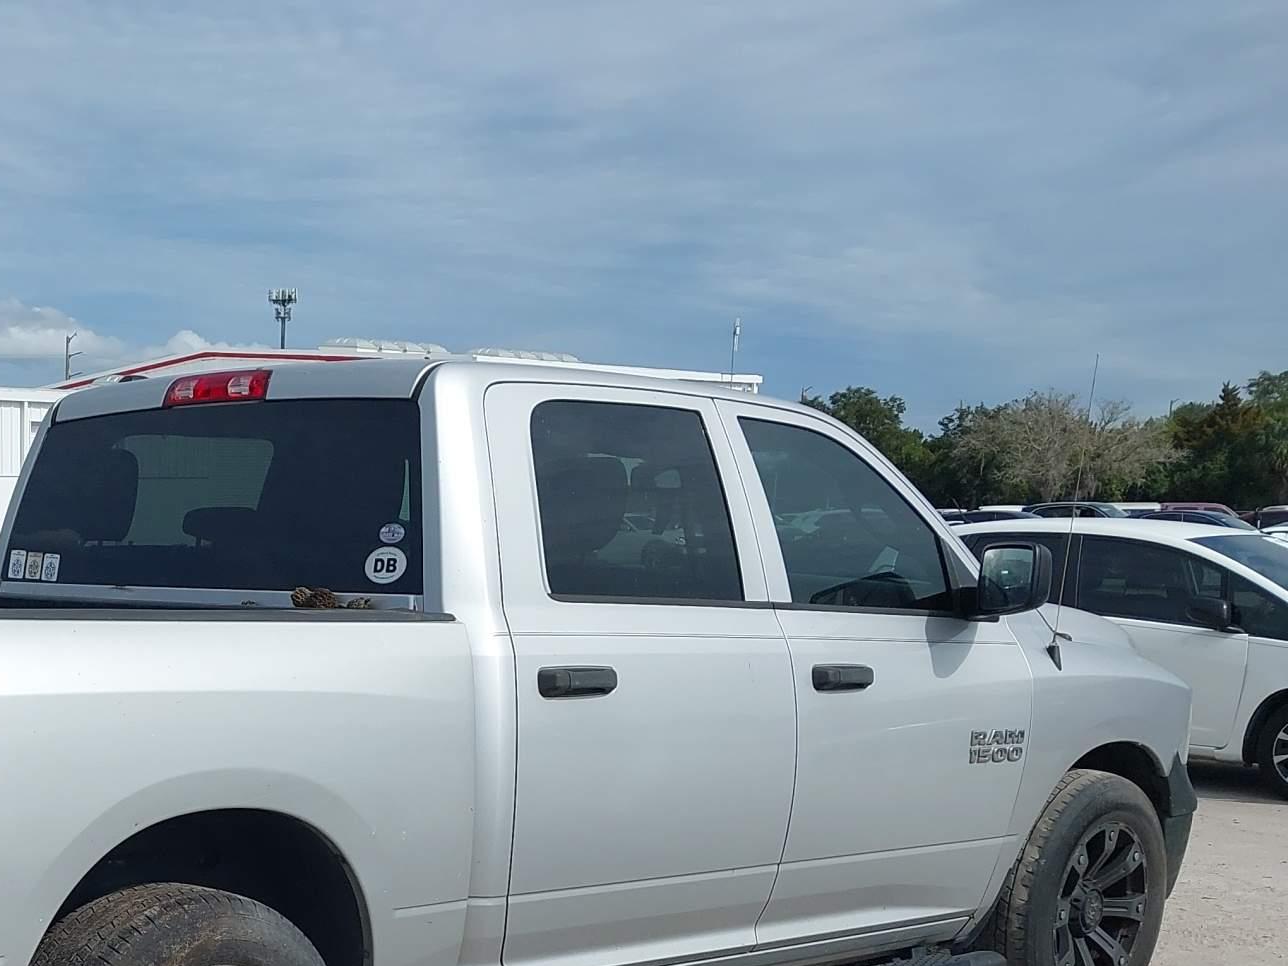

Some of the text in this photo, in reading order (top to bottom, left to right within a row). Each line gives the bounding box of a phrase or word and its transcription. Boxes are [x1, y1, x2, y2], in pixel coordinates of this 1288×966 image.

[373, 557, 397, 573] DB
[970, 729, 1025, 746] RAM
[969, 746, 1023, 764] 1500
